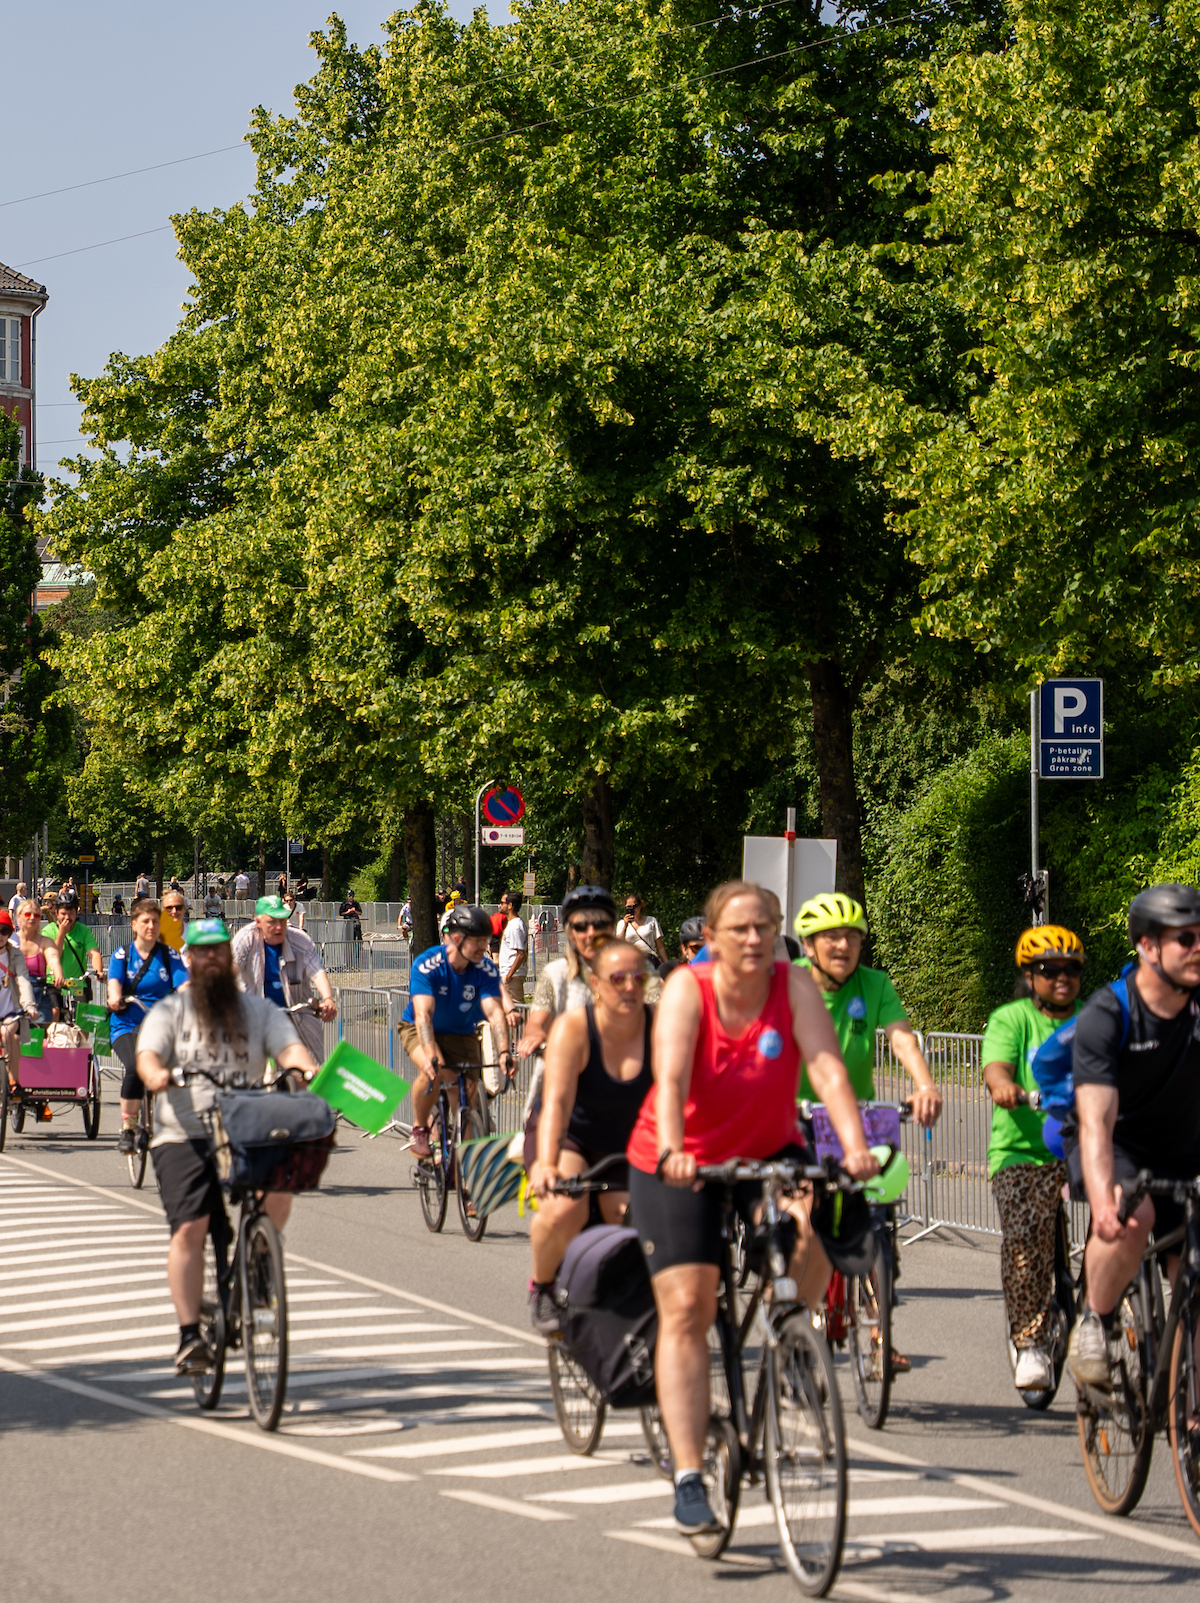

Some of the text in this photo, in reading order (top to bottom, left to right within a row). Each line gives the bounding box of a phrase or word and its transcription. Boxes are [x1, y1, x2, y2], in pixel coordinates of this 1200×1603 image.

[1054, 687, 1096, 734] P info
[1049, 764, 1070, 772] Grøn
